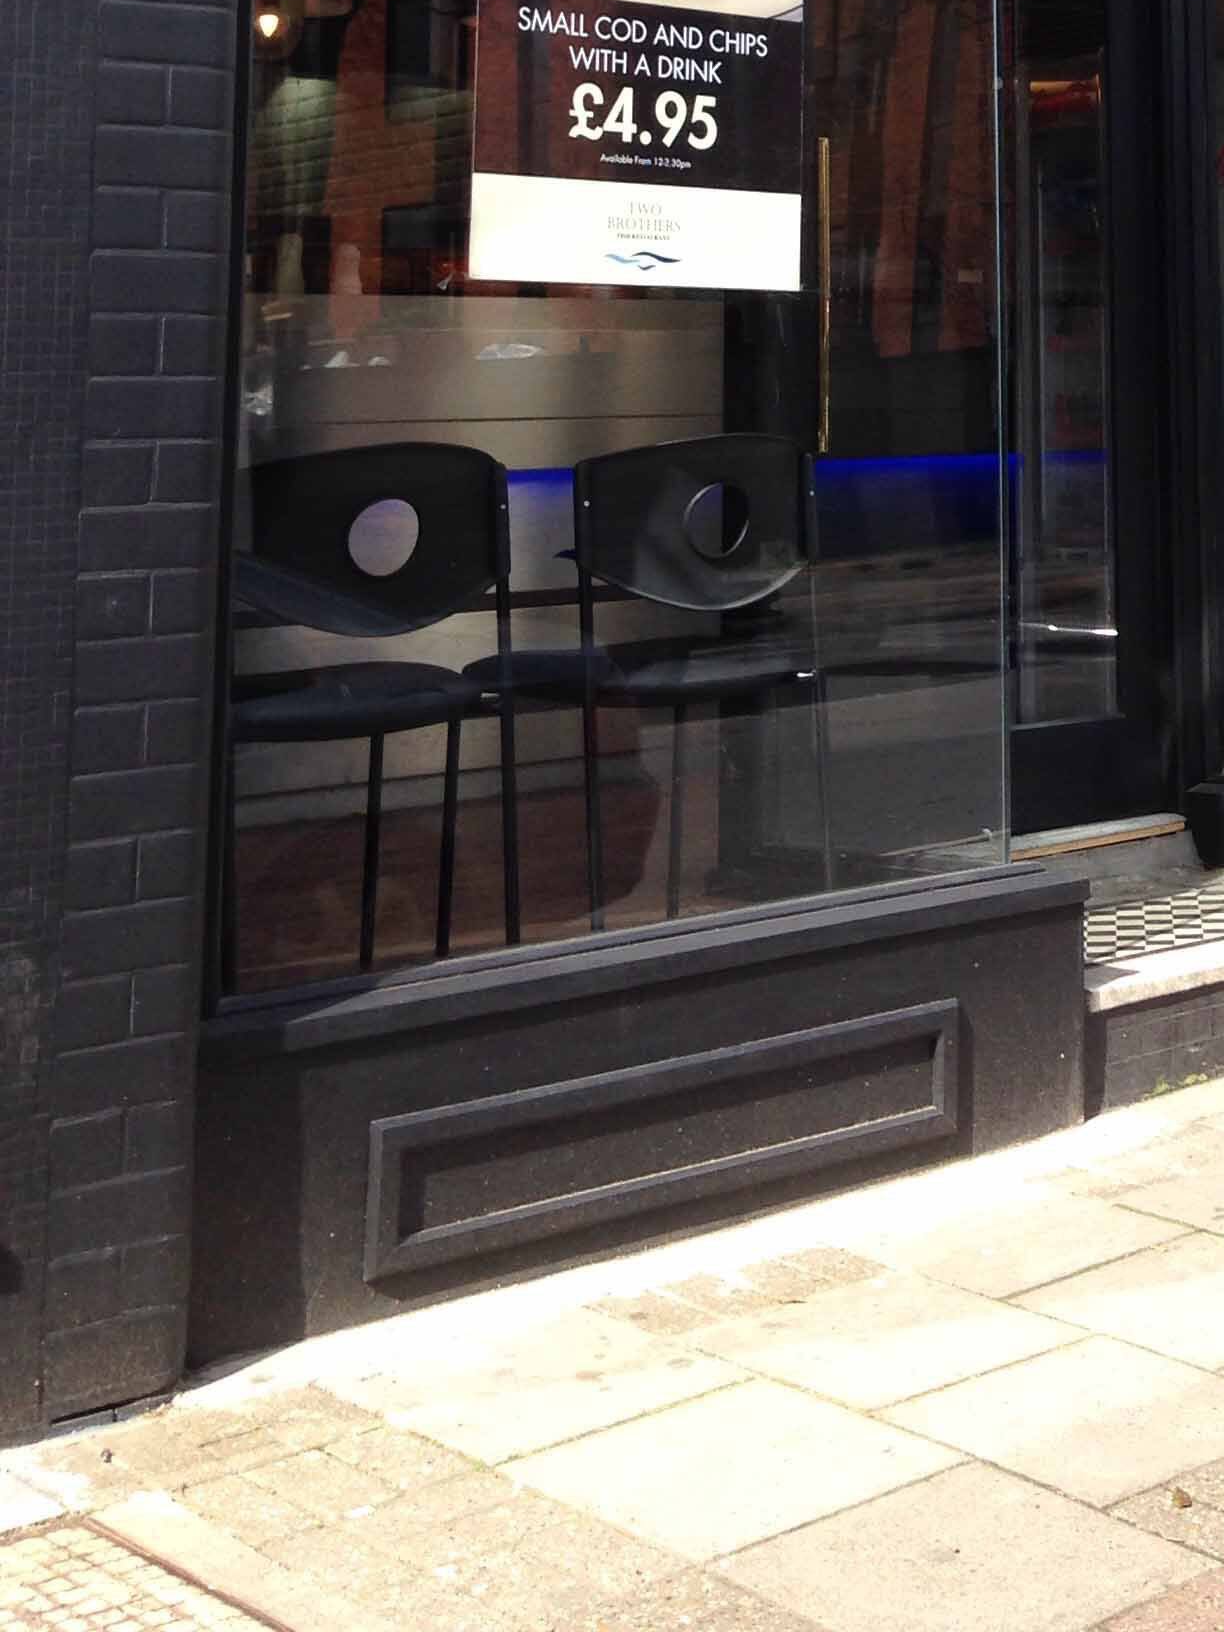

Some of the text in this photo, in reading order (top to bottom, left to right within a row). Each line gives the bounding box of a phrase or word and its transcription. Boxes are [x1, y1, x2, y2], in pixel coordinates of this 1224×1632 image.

[518, 7, 768, 57] SMALL COD AND CHIPS
[569, 46, 722, 84] WITH A DRINK
[569, 82, 718, 150] £4.95
[600, 153, 633, 165] Available
[634, 155, 652, 166] From
[608, 199, 681, 233] TWO BROTHERS
